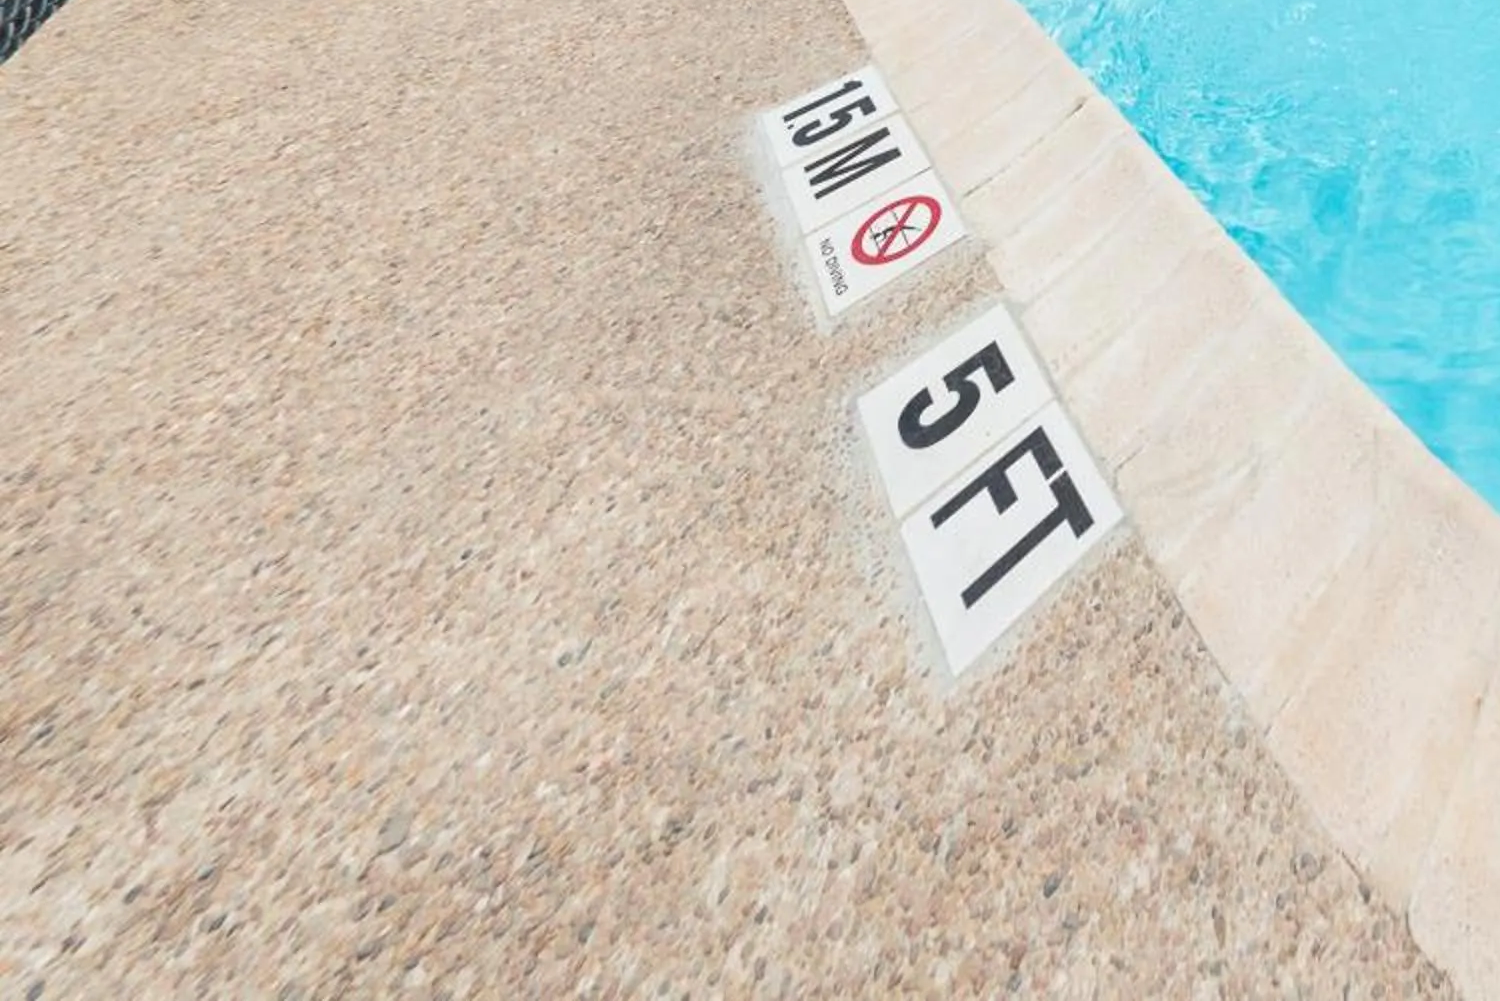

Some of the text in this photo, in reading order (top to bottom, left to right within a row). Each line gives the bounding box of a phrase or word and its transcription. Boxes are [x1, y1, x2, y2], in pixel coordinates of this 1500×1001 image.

[819, 237, 849, 296] NO DIVING
[898, 339, 1096, 610] 5 FT
